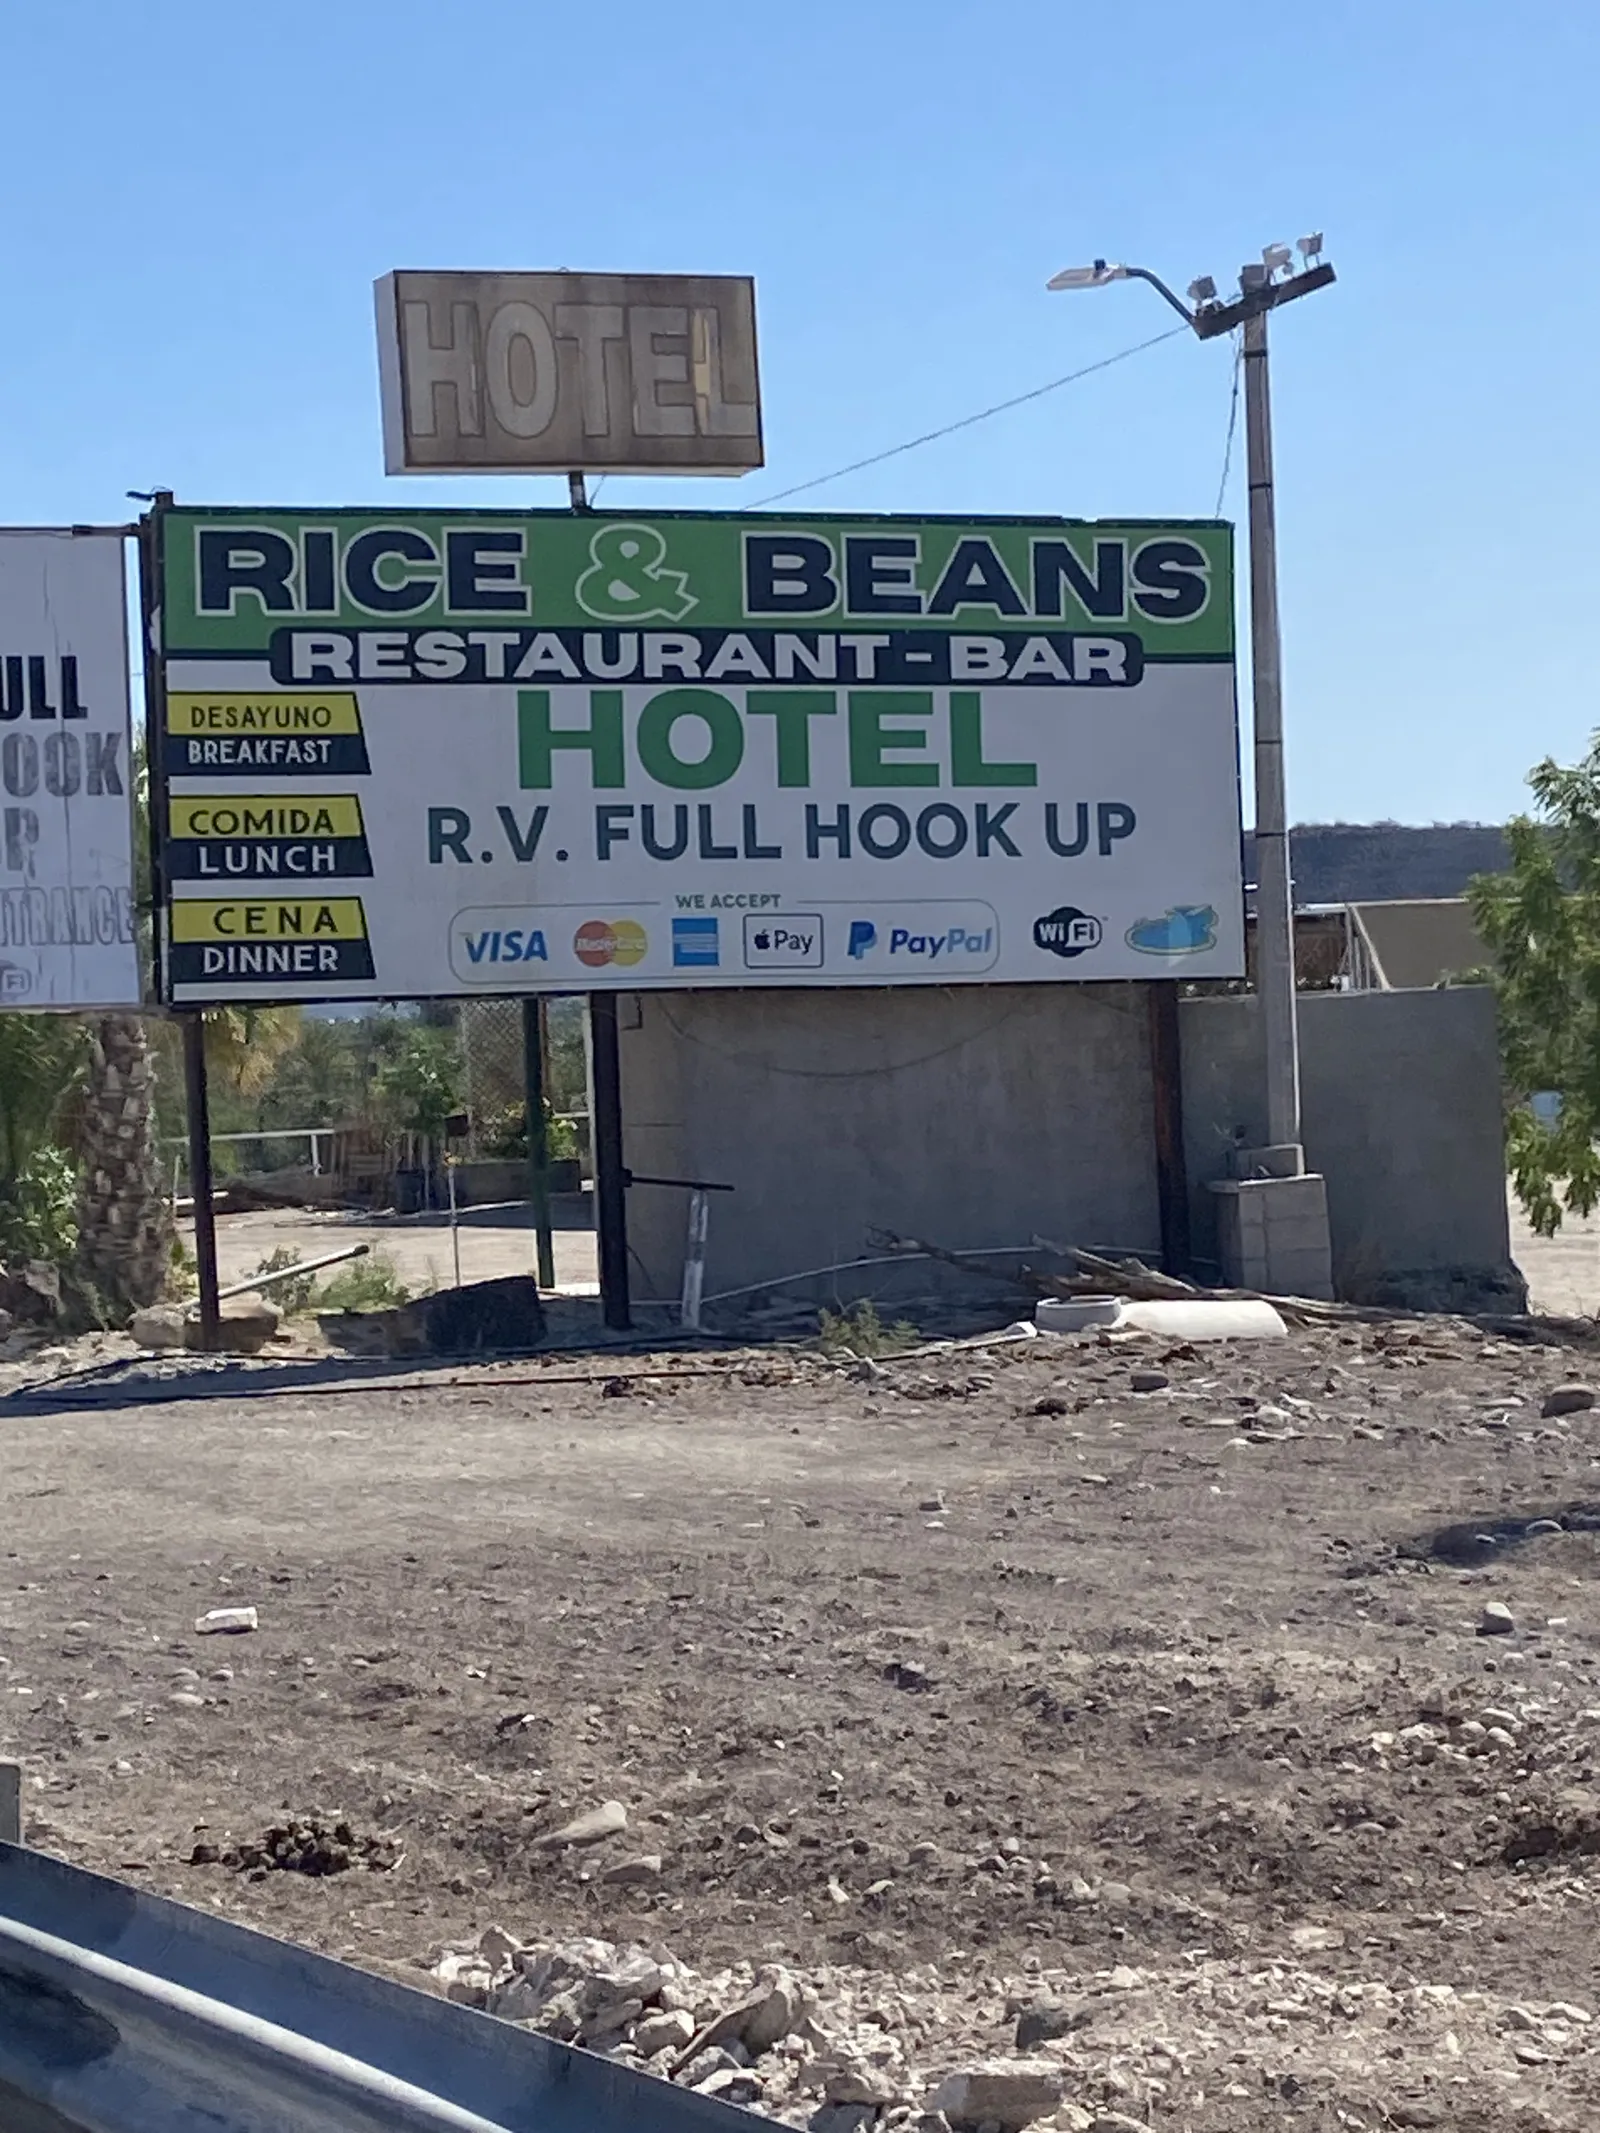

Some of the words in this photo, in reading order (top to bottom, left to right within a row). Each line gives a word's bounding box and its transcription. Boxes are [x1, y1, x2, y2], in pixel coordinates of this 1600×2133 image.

[404, 301, 757, 438] HOTEL
[196, 526, 531, 617] RICE
[576, 524, 699, 621] &
[741, 531, 1212, 623] BEANS
[190, 705, 332, 729] DESAYUNO
[188, 739, 332, 764] BREAKFAST
[517, 689, 1037, 790] HOTEL
[188, 808, 335, 835] COMIDA
[427, 807, 570, 864] R.V.
[596, 804, 782, 862] FULL
[805, 802, 1023, 860] HOOK
[1044, 802, 1137, 857] UP
[199, 845, 336, 873] LUNCH
[675, 895, 705, 908] WE
[710, 894, 782, 908] ACCEPT
[0, 886, 136, 946] TRANCE
[213, 906, 339, 935] CENA
[461, 931, 548, 963] VISA
[773, 930, 814, 955] Pay
[888, 928, 993, 958] PayPal
[203, 944, 339, 973] DINNER
